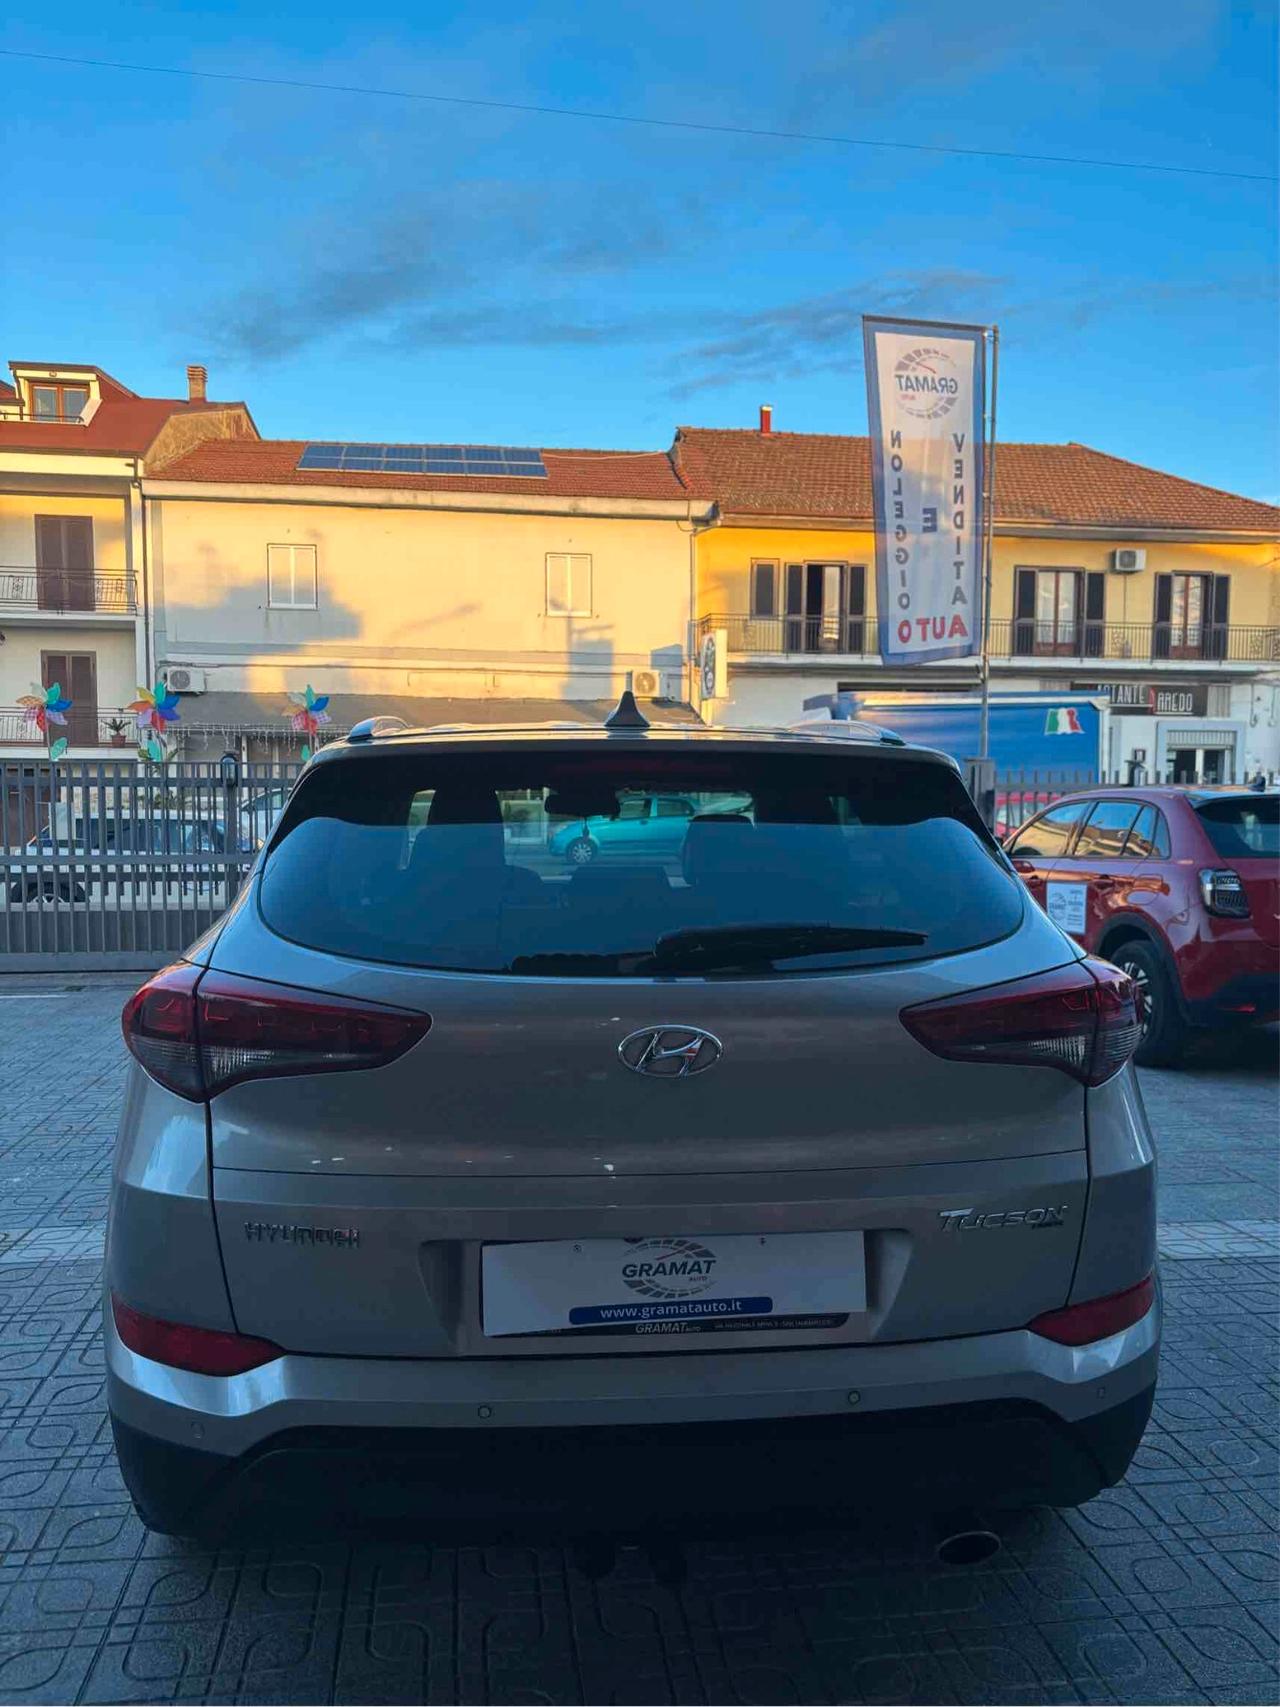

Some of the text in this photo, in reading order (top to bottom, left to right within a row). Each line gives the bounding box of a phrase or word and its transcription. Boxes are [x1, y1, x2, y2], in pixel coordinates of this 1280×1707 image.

[939, 1205, 1069, 1232] TUCSON
[244, 1222, 360, 1247] HYUNDAI
[622, 1259, 717, 1278] GRAMAT
[599, 1299, 742, 1319] www.gramatauto.it
[634, 1321, 688, 1335] GRAMAT
